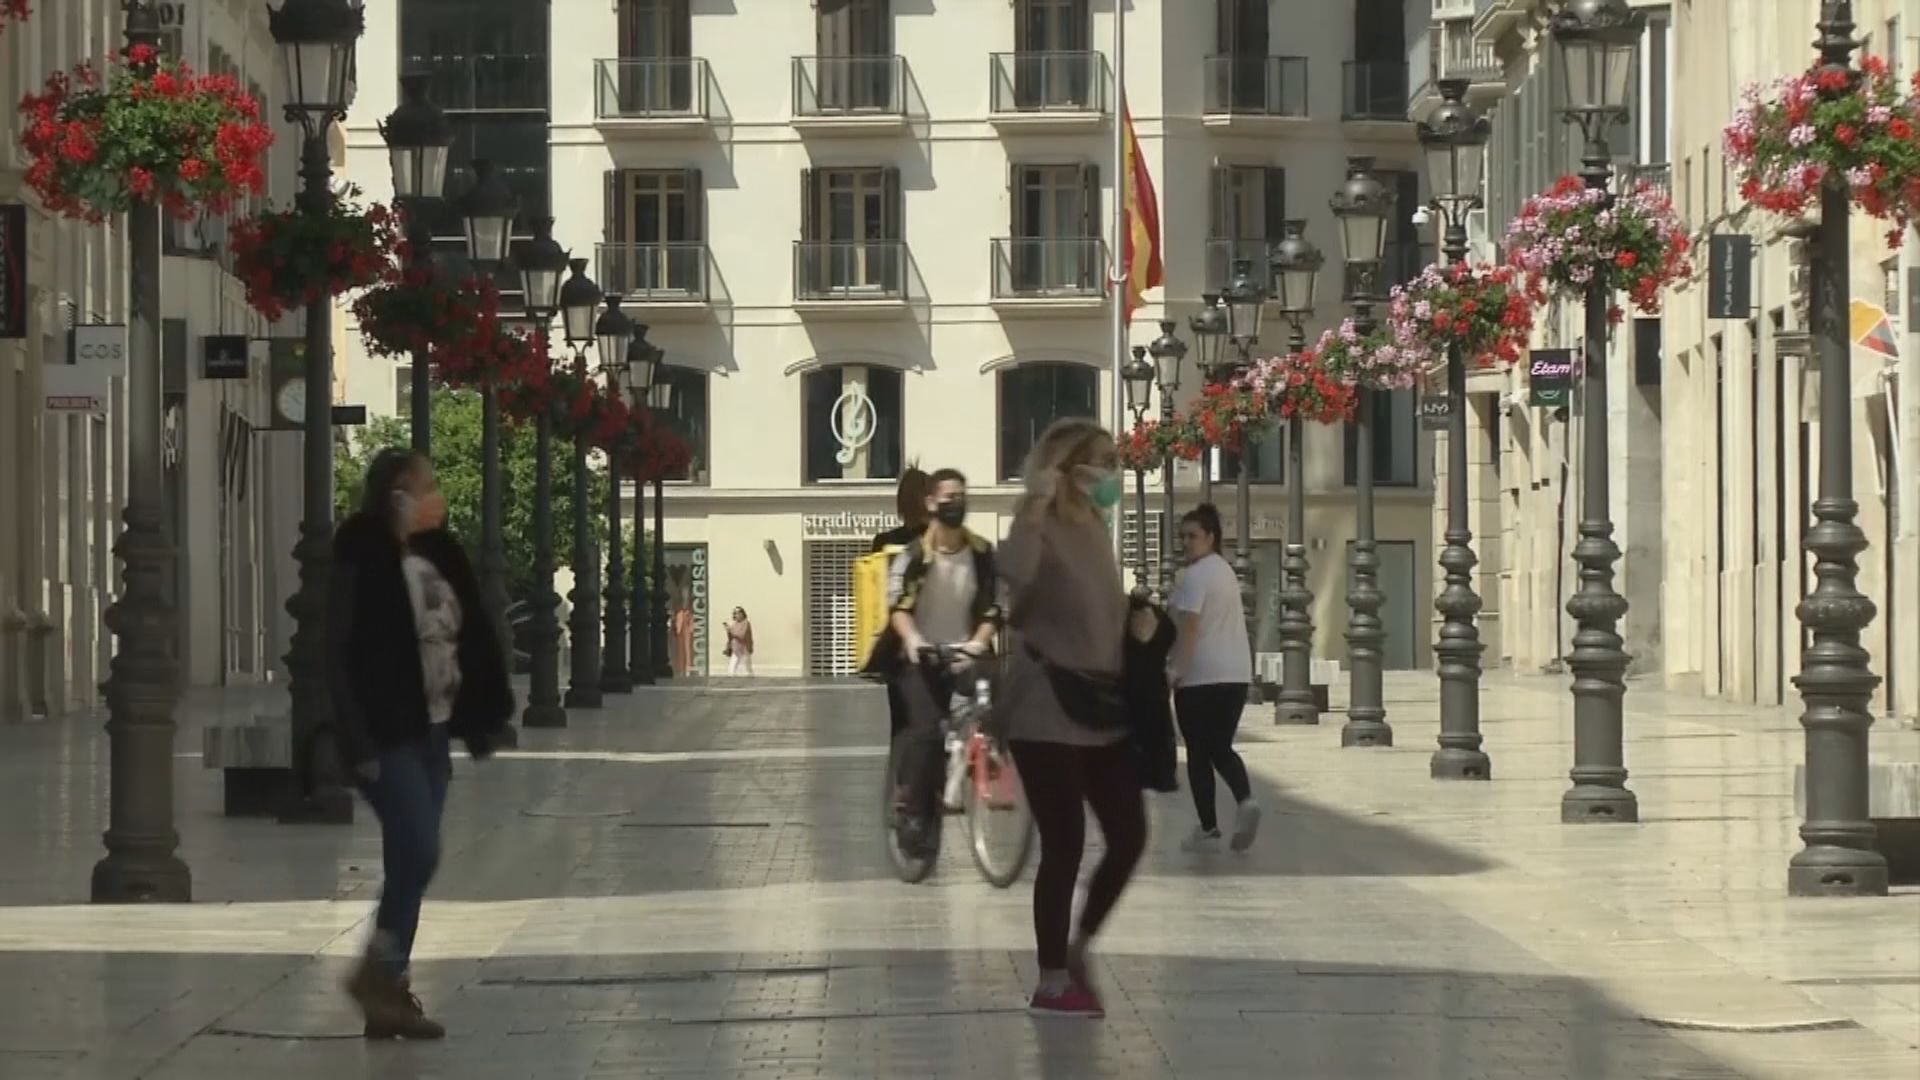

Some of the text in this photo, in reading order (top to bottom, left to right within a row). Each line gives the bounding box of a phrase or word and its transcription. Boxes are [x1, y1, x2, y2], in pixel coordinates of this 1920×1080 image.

[80, 343, 122, 359] COS
[1531, 360, 1571, 375] Etam
[687, 548, 706, 678] howcase
